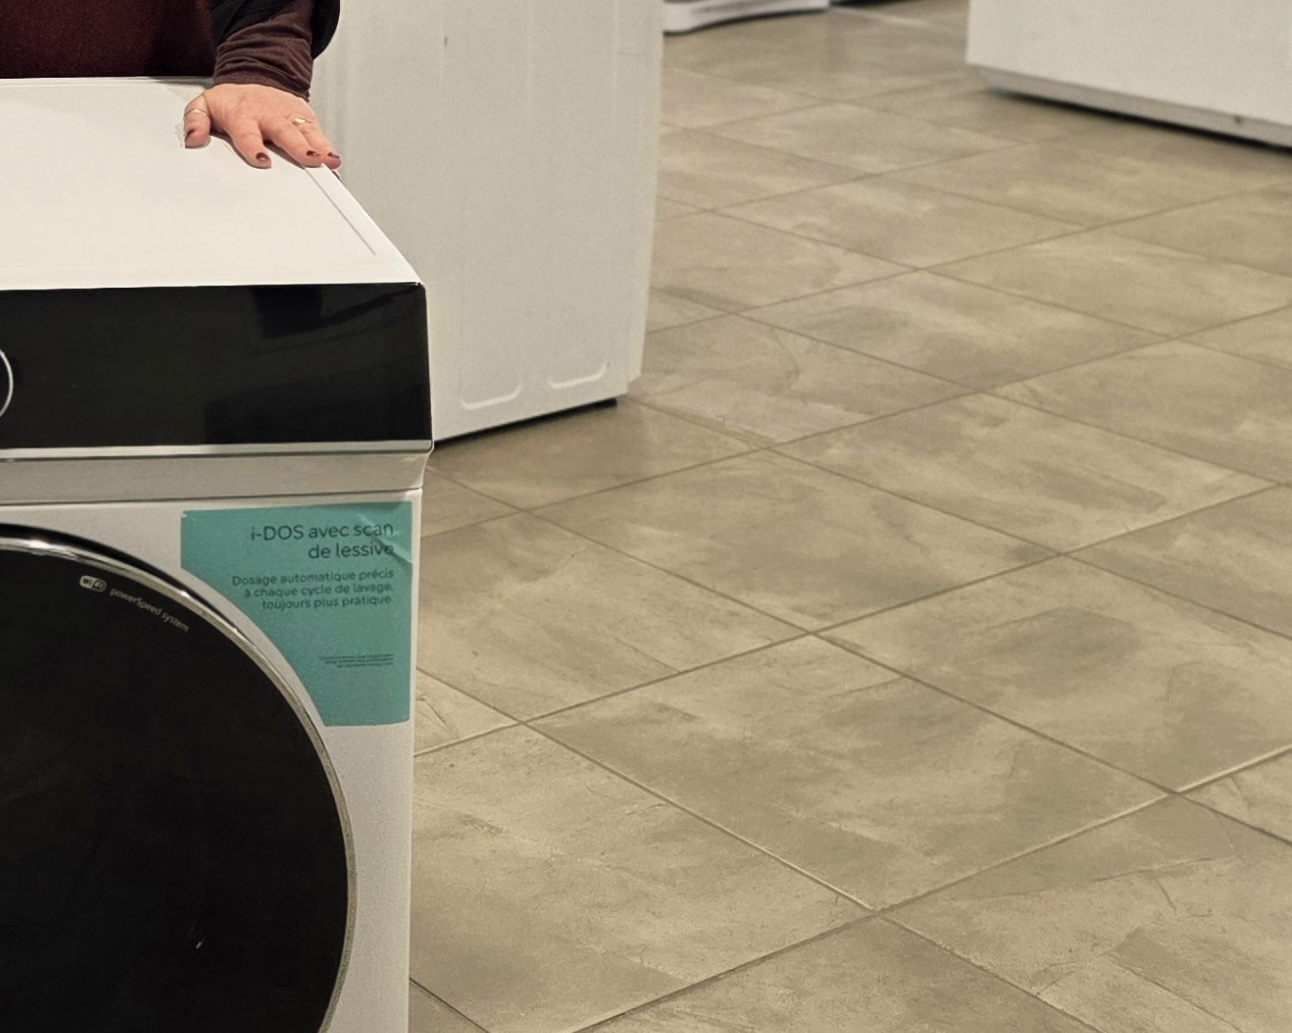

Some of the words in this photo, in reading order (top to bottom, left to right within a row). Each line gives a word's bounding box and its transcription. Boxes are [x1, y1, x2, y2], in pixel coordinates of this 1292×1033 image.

[251, 524, 305, 541] i-DOS
[308, 526, 349, 539] avec
[352, 523, 394, 538] scan
[308, 544, 332, 559] de
[336, 541, 394, 558] lessive
[232, 575, 278, 587] Dosage
[280, 570, 356, 584] automatique
[358, 568, 395, 581] précis
[244, 588, 251, 598] à
[253, 587, 298, 599] chaque
[300, 584, 332, 597] cycle
[334, 583, 350, 595] de
[262, 597, 311, 612] toujours
[313, 595, 340, 609] plus
